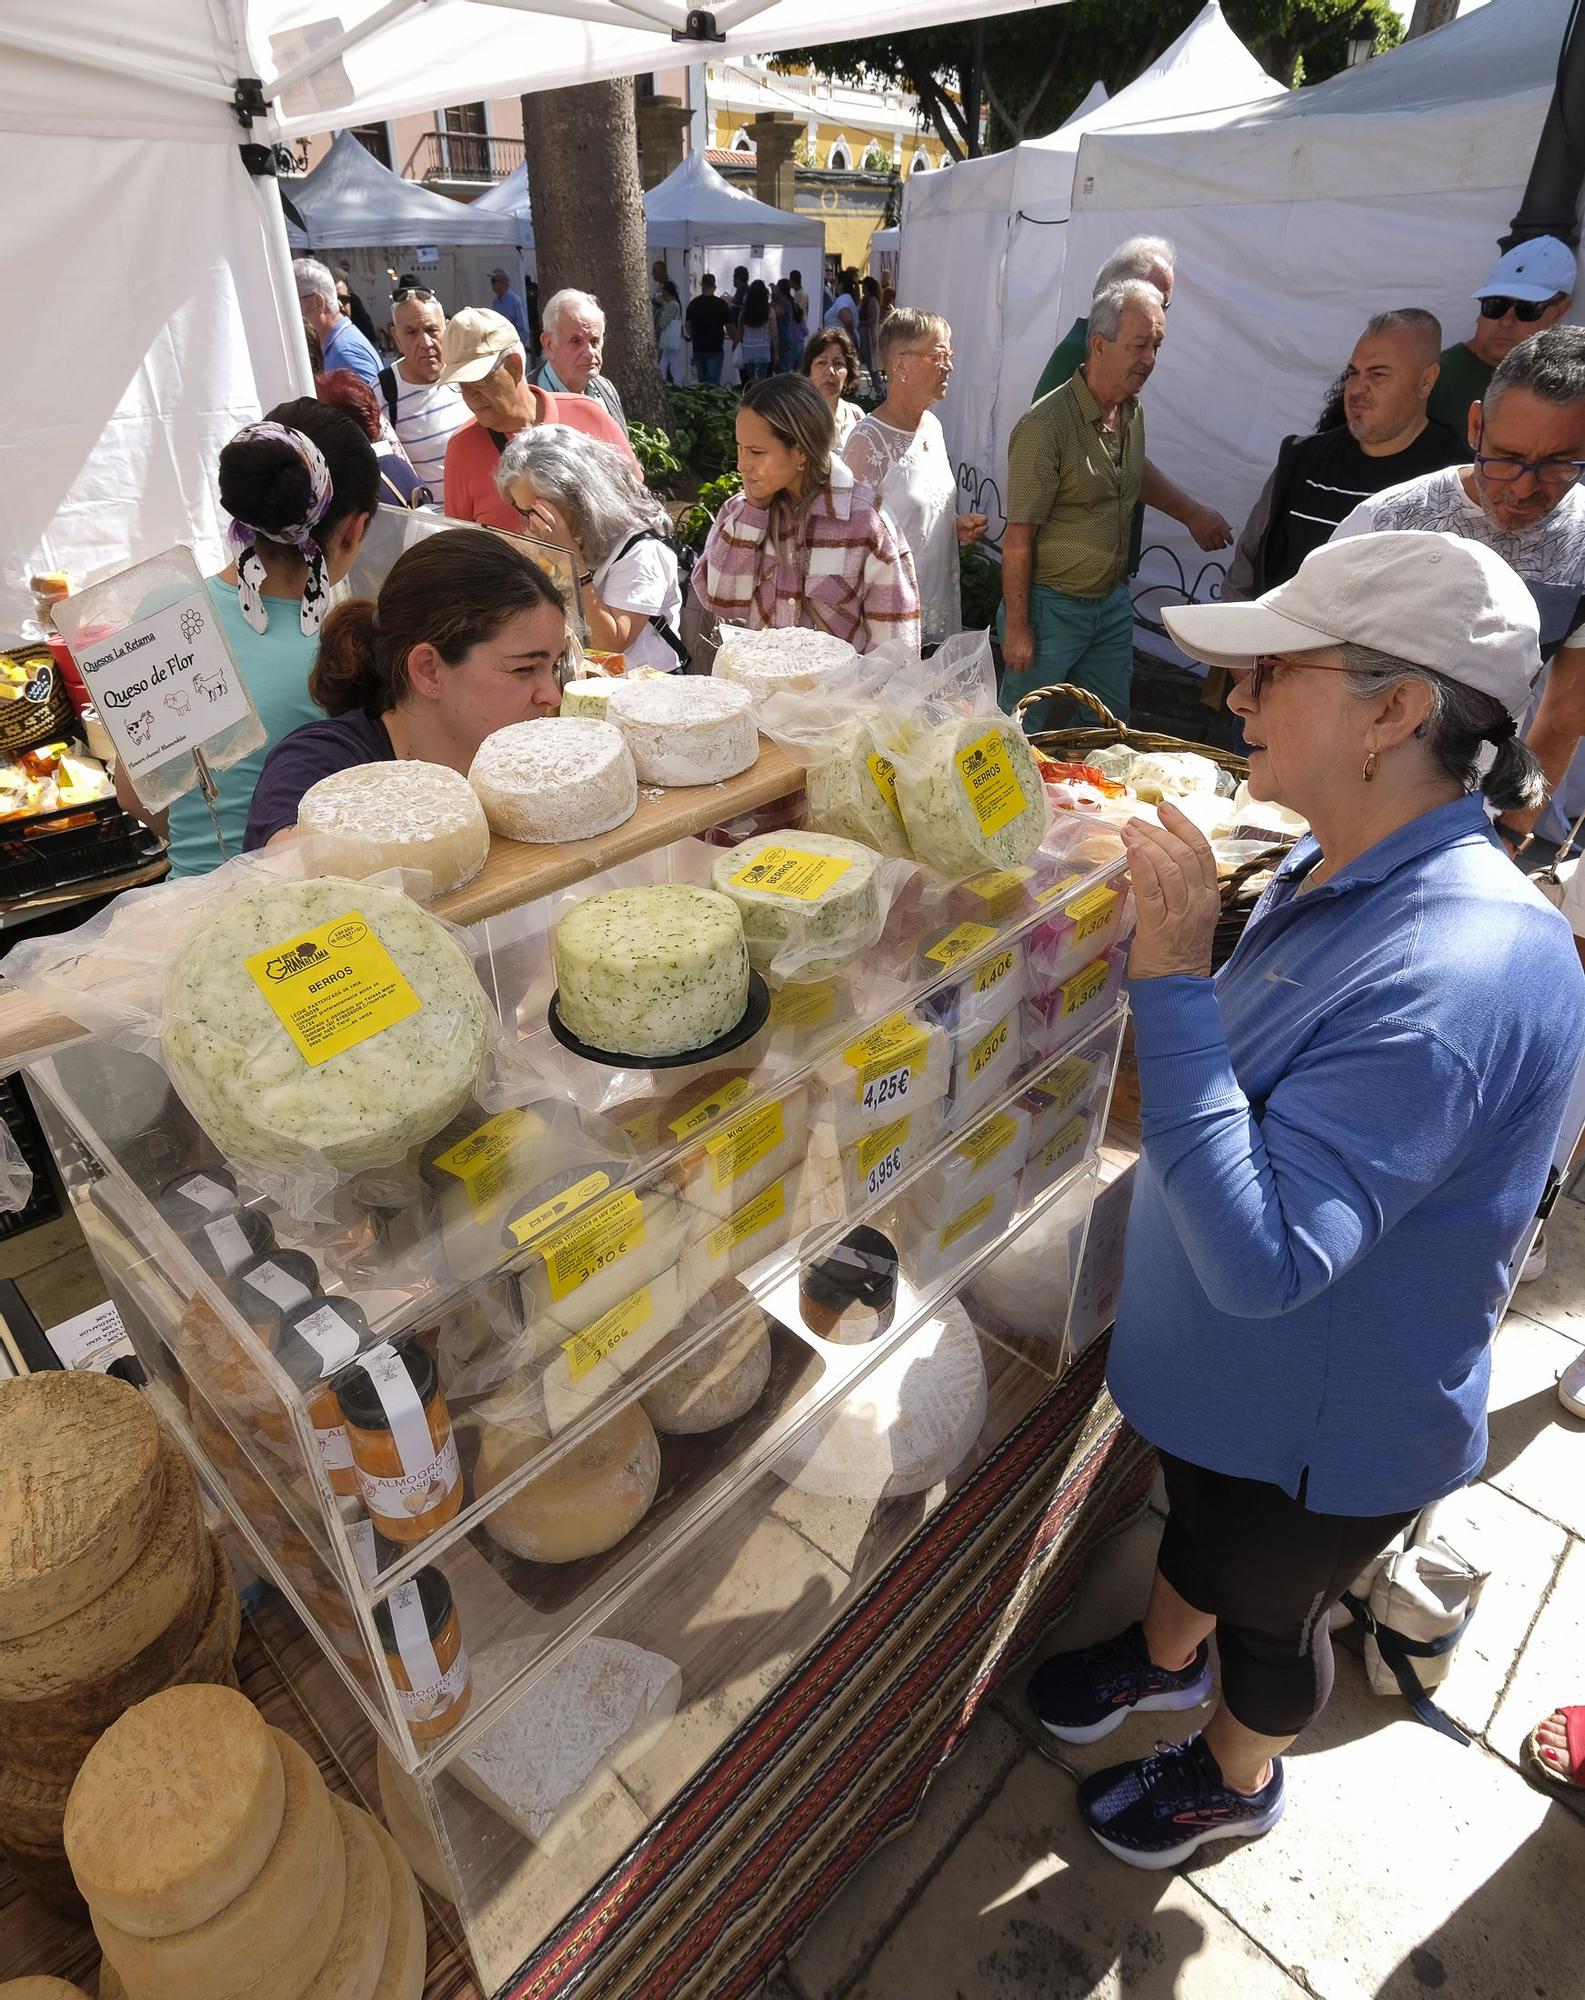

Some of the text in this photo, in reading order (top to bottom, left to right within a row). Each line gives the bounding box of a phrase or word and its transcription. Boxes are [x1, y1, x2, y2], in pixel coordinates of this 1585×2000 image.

[84, 633, 155, 674] Quesos La Retama
[104, 653, 194, 708] Queso de Flor
[973, 764, 1000, 789] BERROS
[766, 861, 797, 884] BERROS
[308, 966, 353, 993] BERROS
[863, 1069, 910, 1110] 4,25€
[869, 1147, 900, 1193] 3,95€
[400, 1467, 443, 1495] CASERO
[410, 1682, 450, 1705] CASERO
